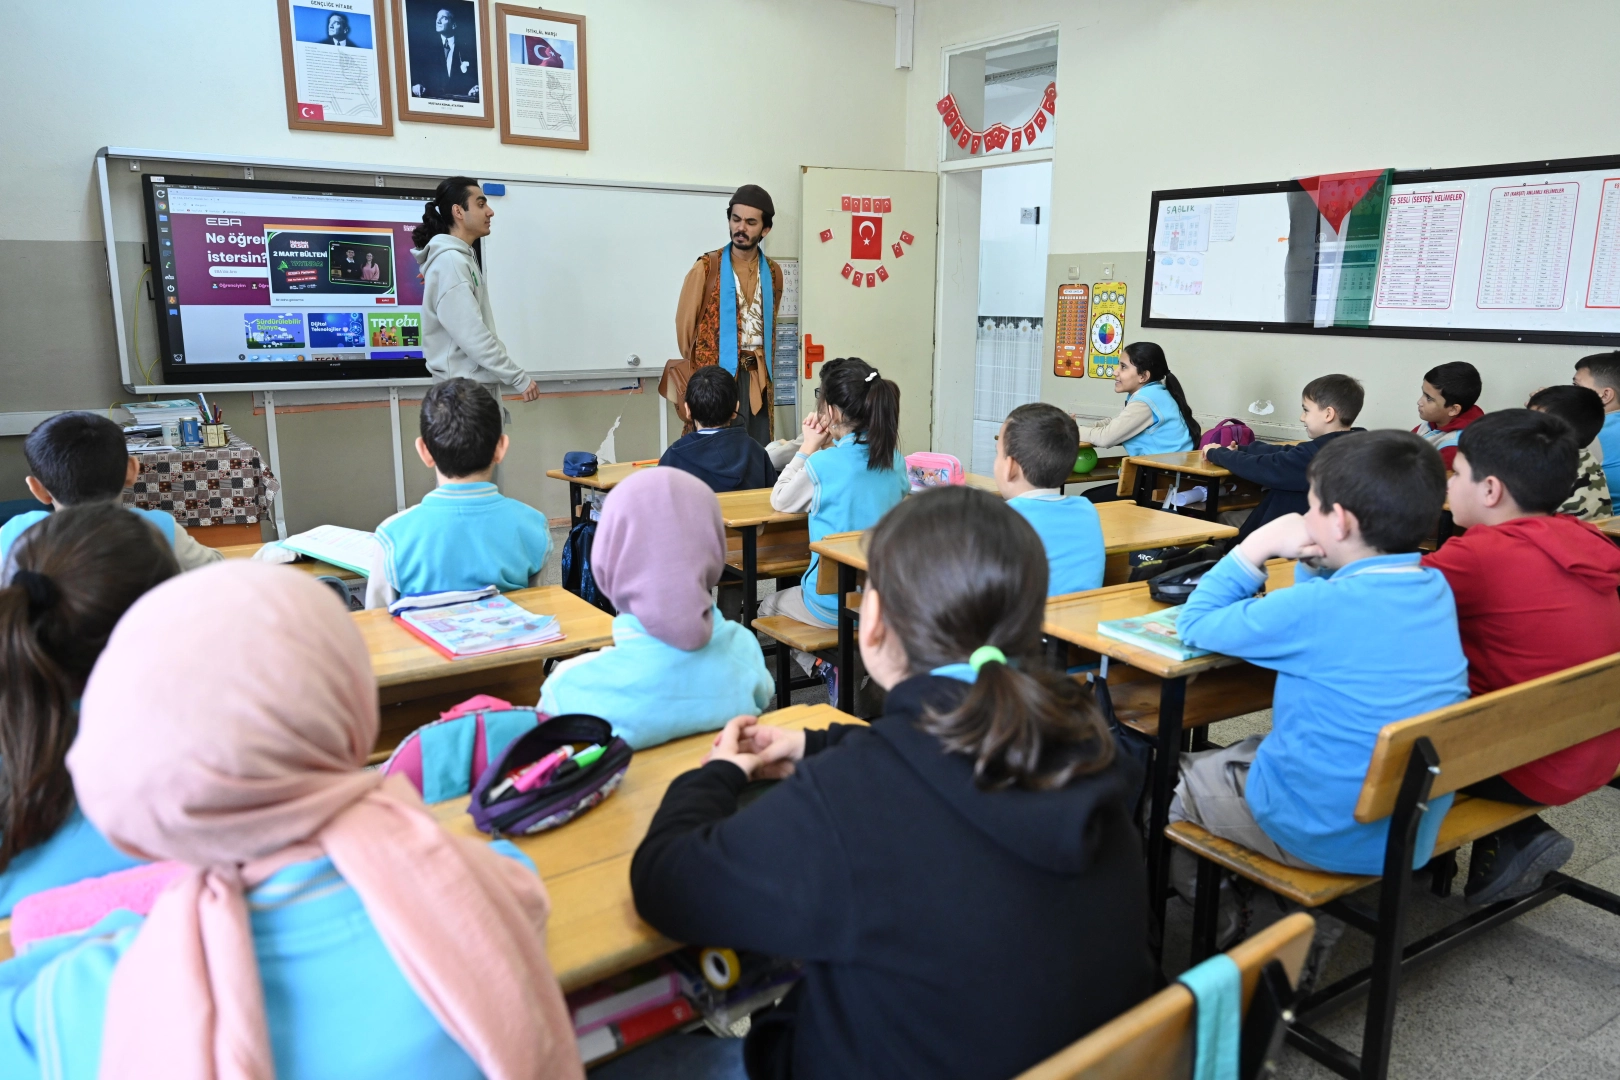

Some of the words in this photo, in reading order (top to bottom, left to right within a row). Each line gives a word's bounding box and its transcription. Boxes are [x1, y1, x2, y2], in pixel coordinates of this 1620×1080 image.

[1397, 196, 1410, 204] SESLİ
[1412, 195, 1432, 204] (SESTEŞ)
[1434, 194, 1462, 202] KELİMELER
[206, 218, 242, 226] EBA
[206, 232, 226, 244] Ne
[207, 250, 267, 264] istersin?
[300, 250, 328, 258] BÜLTENİ
[370, 318, 394, 328] TRT
